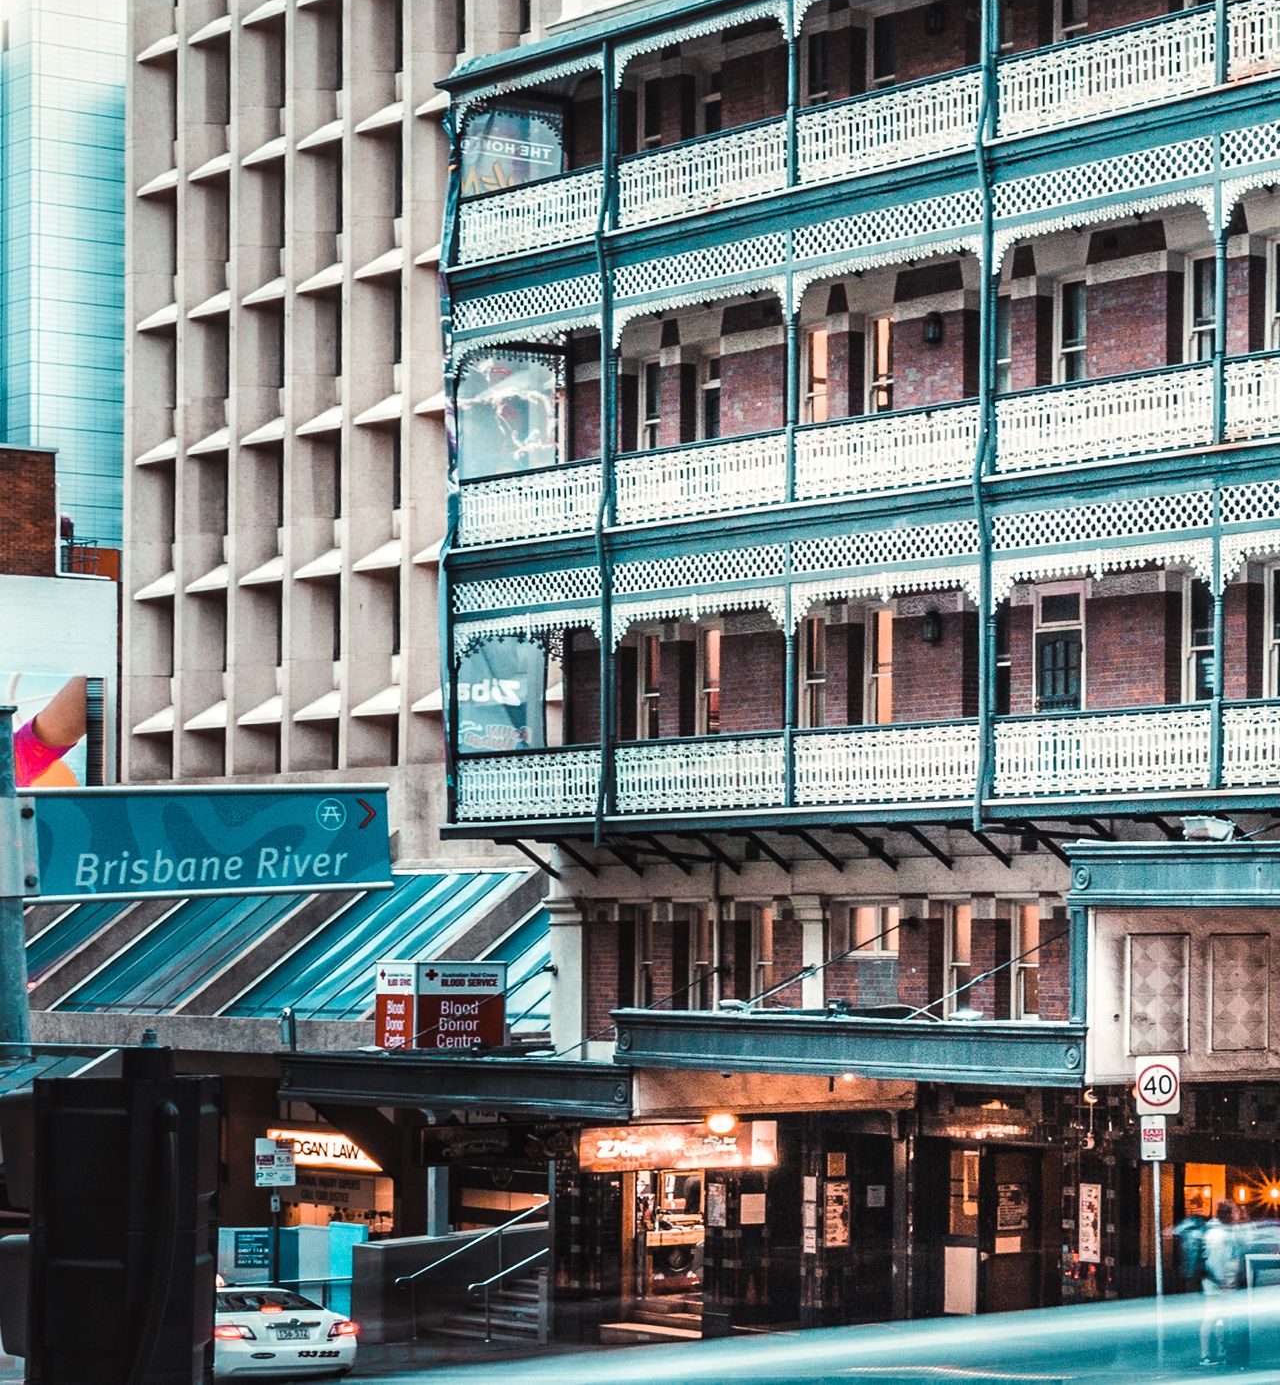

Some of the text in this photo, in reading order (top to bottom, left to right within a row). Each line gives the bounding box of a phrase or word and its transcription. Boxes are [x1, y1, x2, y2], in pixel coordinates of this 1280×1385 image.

[75, 845, 349, 886] Brisbane River
[441, 979, 498, 988] BLOOD SERVICE
[386, 999, 405, 1014] Blood
[441, 1000, 479, 1014] Blood
[385, 1016, 405, 1031] Donor
[439, 1017, 479, 1031] Donor
[384, 1032, 405, 1047] Centre
[436, 1034, 481, 1048] Centre
[1143, 1075, 1172, 1095] 40
[294, 1140, 329, 1157] OGAN
[333, 1142, 360, 1160] LAW
[298, 1350, 340, 1358] 133 222
